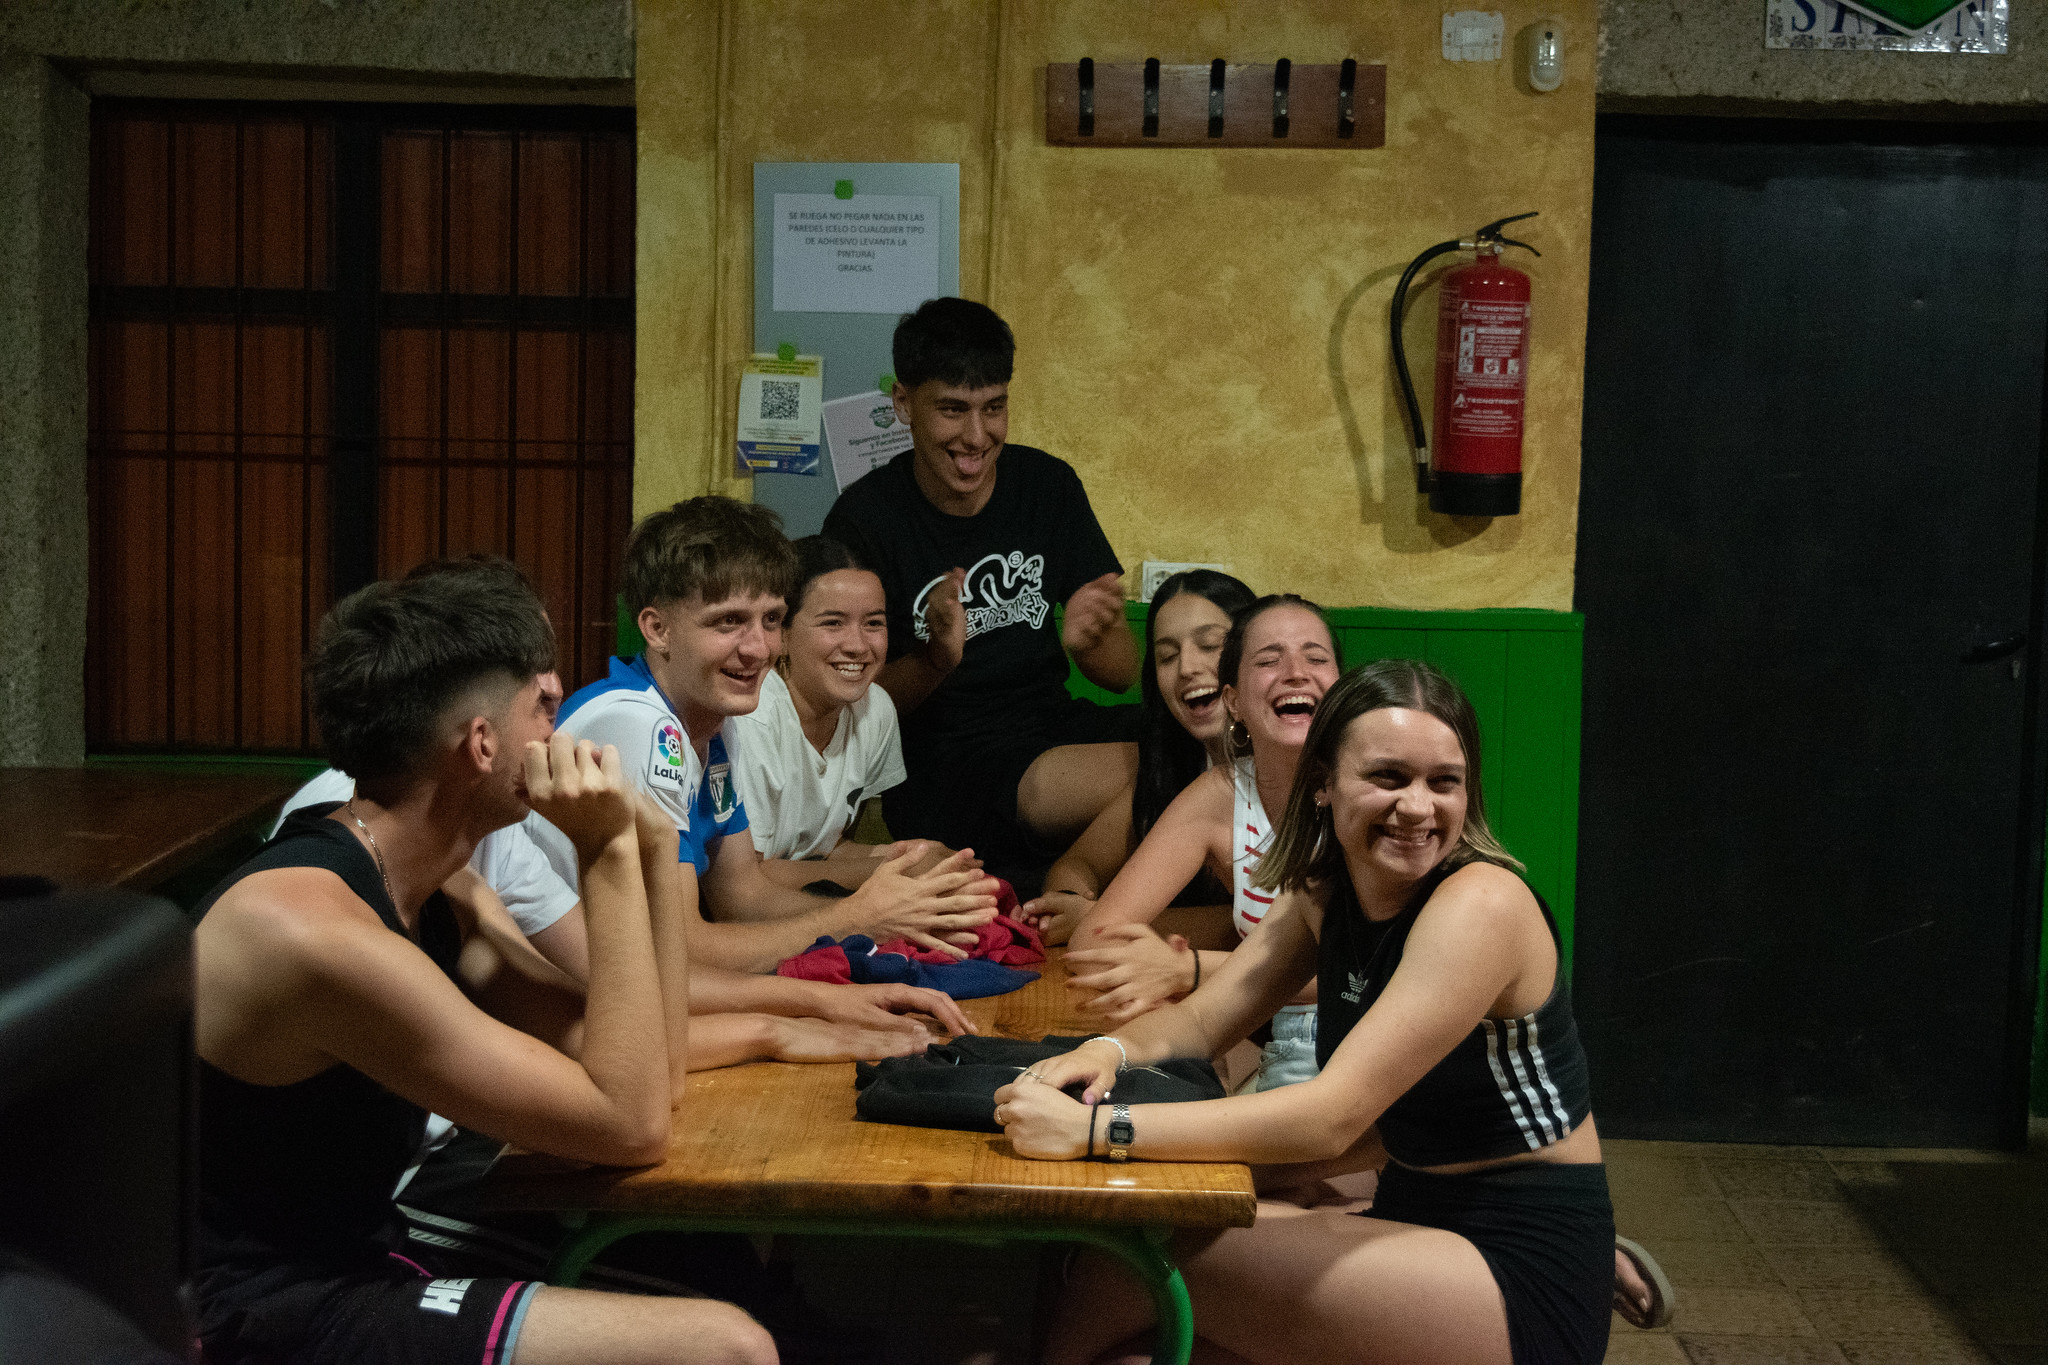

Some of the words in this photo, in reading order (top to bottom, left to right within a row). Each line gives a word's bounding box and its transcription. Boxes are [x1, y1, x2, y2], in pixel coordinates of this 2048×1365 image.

[788, 212, 798, 220] SE
[800, 212, 827, 220] RUEGA
[872, 213, 895, 221] NADA
[859, 226, 904, 234] CUALQUIER
[860, 238, 895, 246] LEVANTA
[654, 764, 684, 787] LaLig
